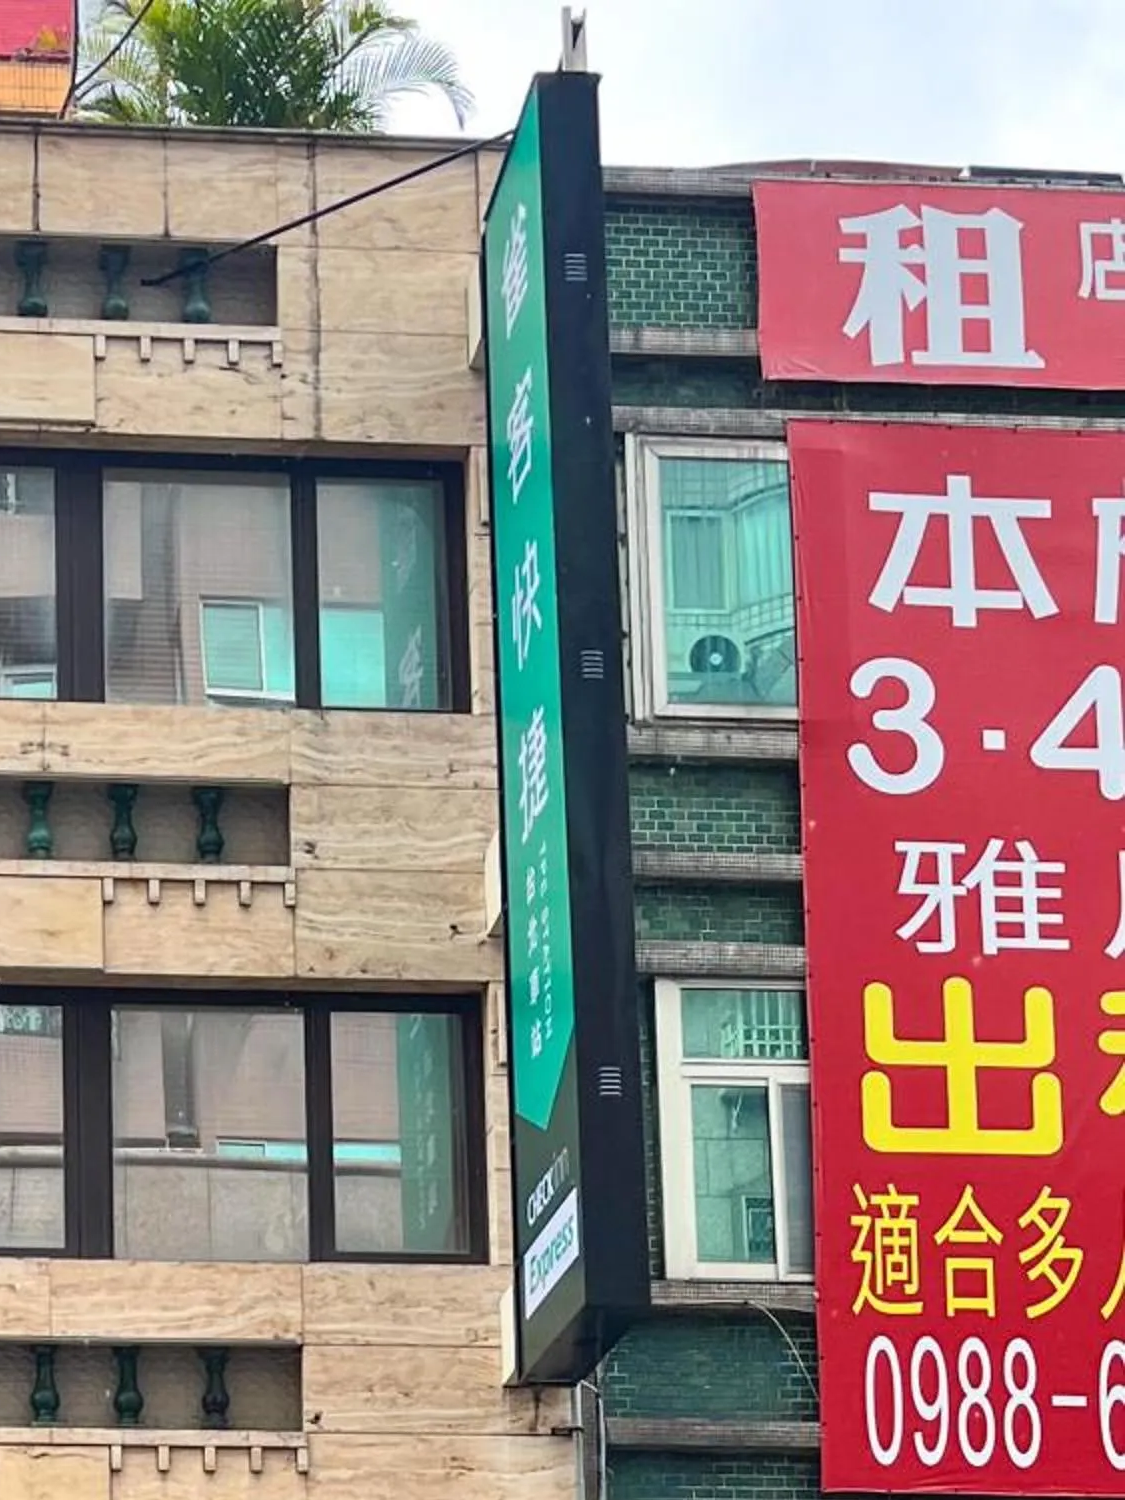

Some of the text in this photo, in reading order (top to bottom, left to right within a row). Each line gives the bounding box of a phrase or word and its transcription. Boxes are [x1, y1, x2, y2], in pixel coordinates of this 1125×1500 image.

[838, 203, 1045, 369] 租
[501, 203, 549, 845] 雀客快捷
[893, 836, 1125, 960] 雅
[860, 975, 1125, 1158] 出
[529, 1214, 574, 1296] Express
[850, 1183, 1125, 1320] 適合多
